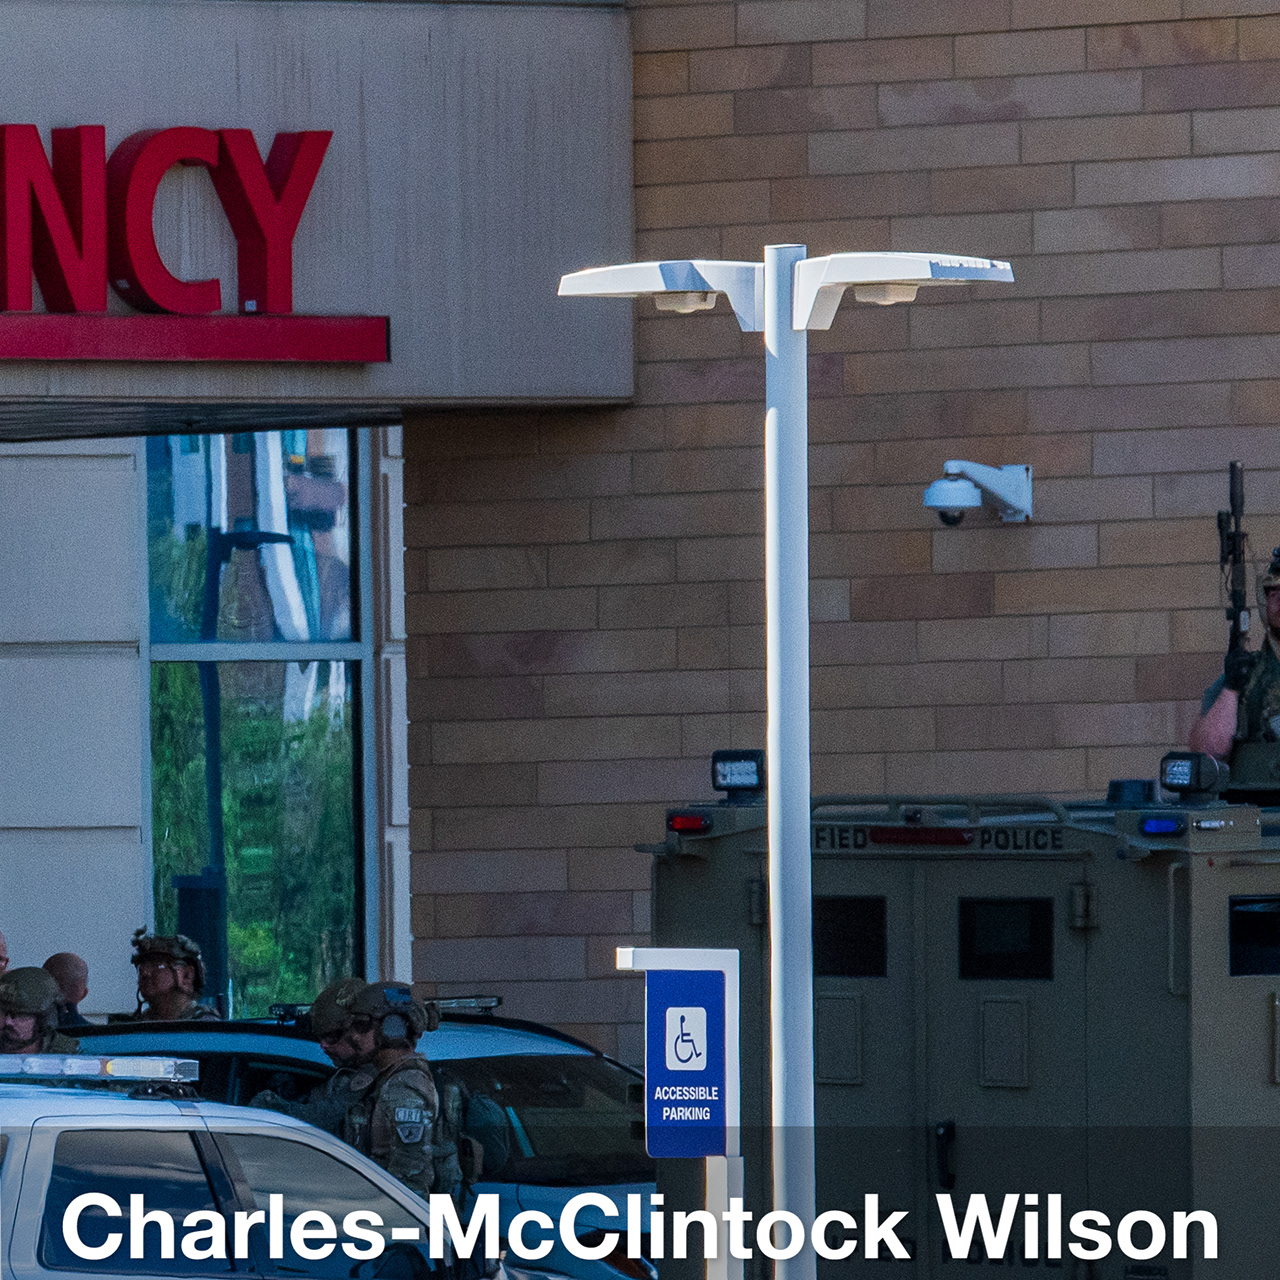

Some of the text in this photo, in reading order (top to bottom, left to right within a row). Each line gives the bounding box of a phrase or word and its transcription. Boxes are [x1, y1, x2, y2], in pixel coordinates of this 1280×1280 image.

[815, 827, 1065, 850] FIED POLICE
[654, 1086, 719, 1100] ACCESSIBLE
[662, 1106, 711, 1121] PARKING
